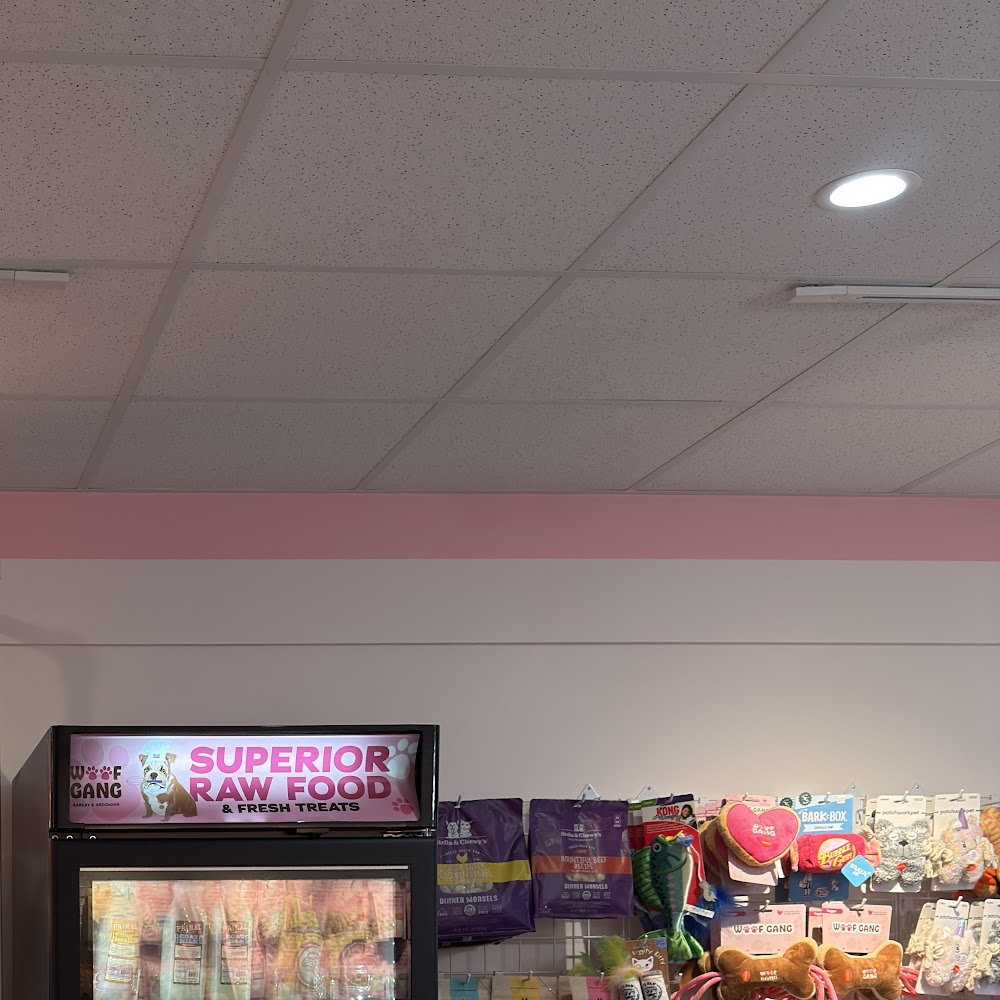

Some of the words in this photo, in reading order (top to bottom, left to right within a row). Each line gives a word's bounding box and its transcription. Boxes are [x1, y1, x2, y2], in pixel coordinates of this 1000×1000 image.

[190, 746, 390, 772] SUPERIOR
[70, 782, 122, 799] GANG
[190, 776, 273, 802] RAW
[288, 775, 392, 800] FOOD
[222, 804, 232, 814] &
[238, 803, 291, 814] FRESH
[296, 802, 360, 812] TREATS
[656, 806, 680, 816] KONG
[752, 828, 776, 837] GANG
[466, 895, 498, 903] MORSELS
[176, 923, 202, 932] PRIMAL
[767, 924, 792, 932] GANG
[858, 924, 880, 932] GANG
